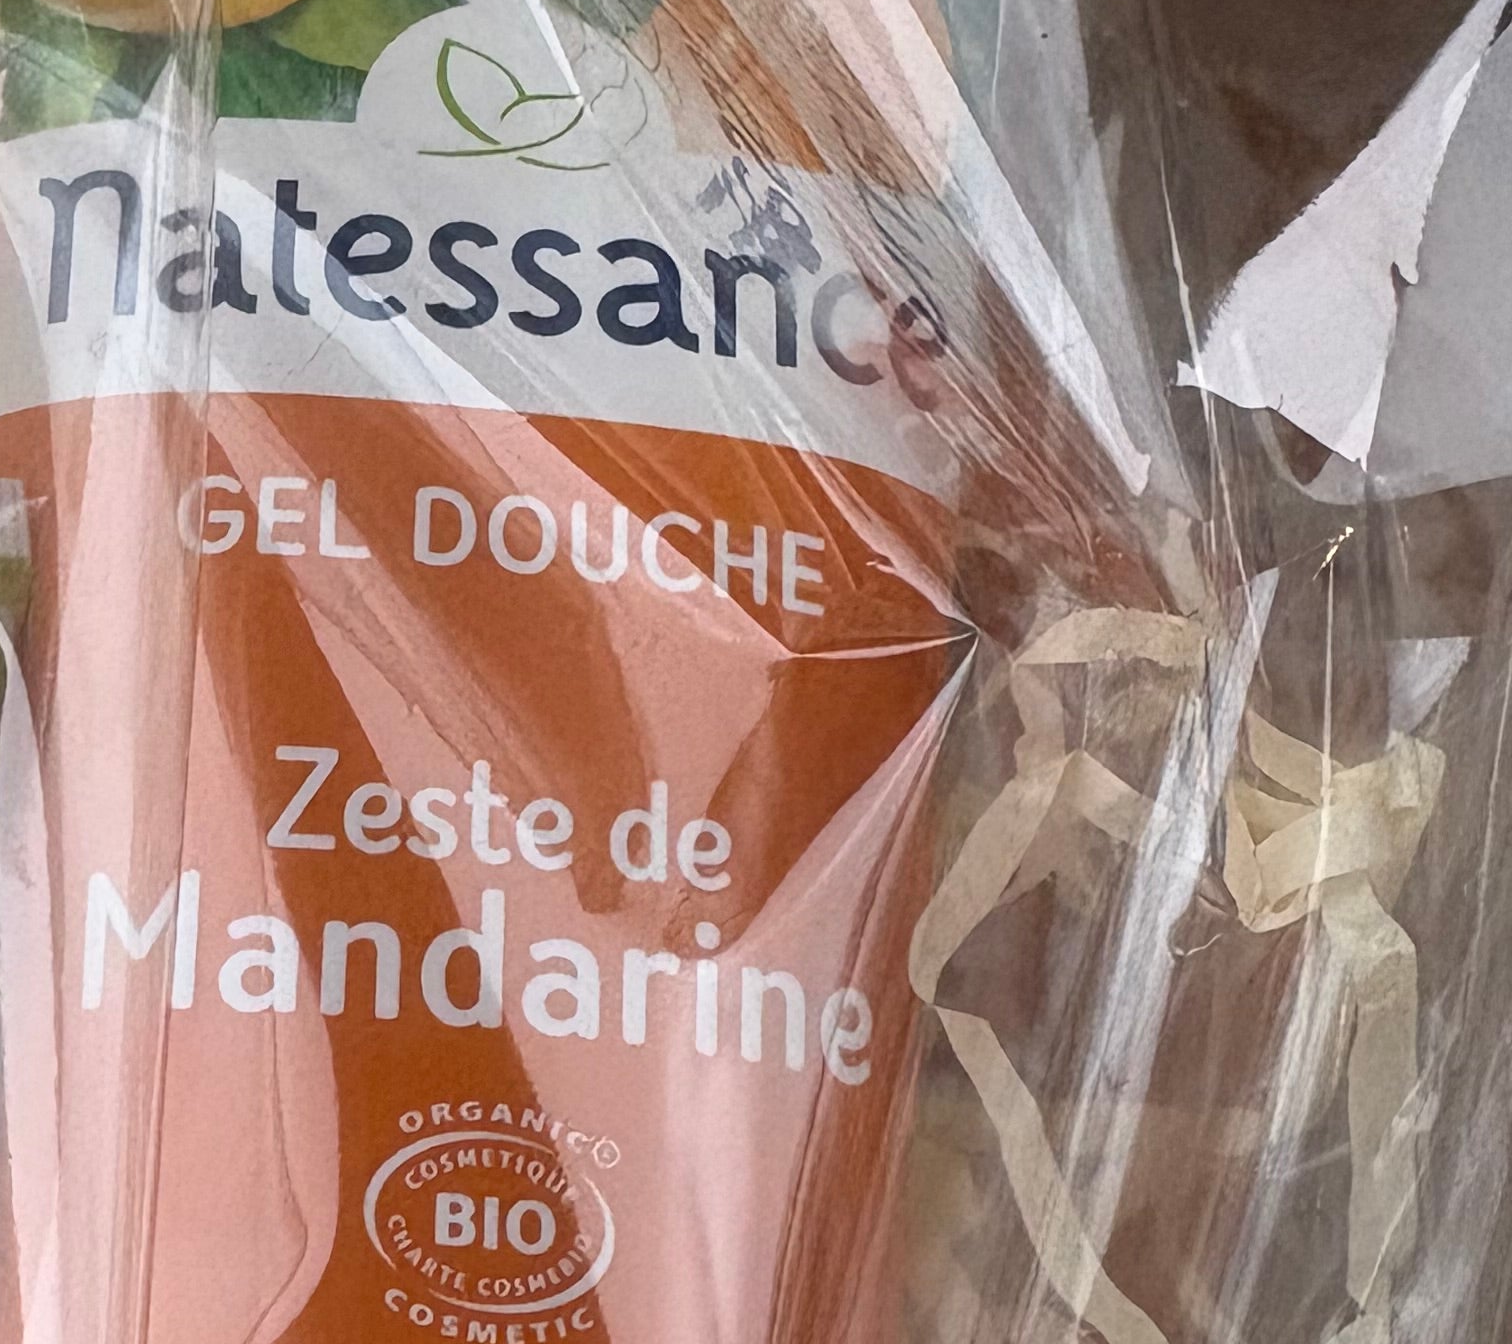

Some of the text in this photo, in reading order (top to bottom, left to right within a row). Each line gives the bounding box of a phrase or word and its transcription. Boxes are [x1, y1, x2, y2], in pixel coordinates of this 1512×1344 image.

[182, 474, 827, 616] GEL DOUCHE
[265, 744, 733, 893] Zeste de
[81, 870, 874, 1087] Mandarine
[388, 1213, 467, 1293] CHARTE
[434, 1192, 557, 1256] BIO
